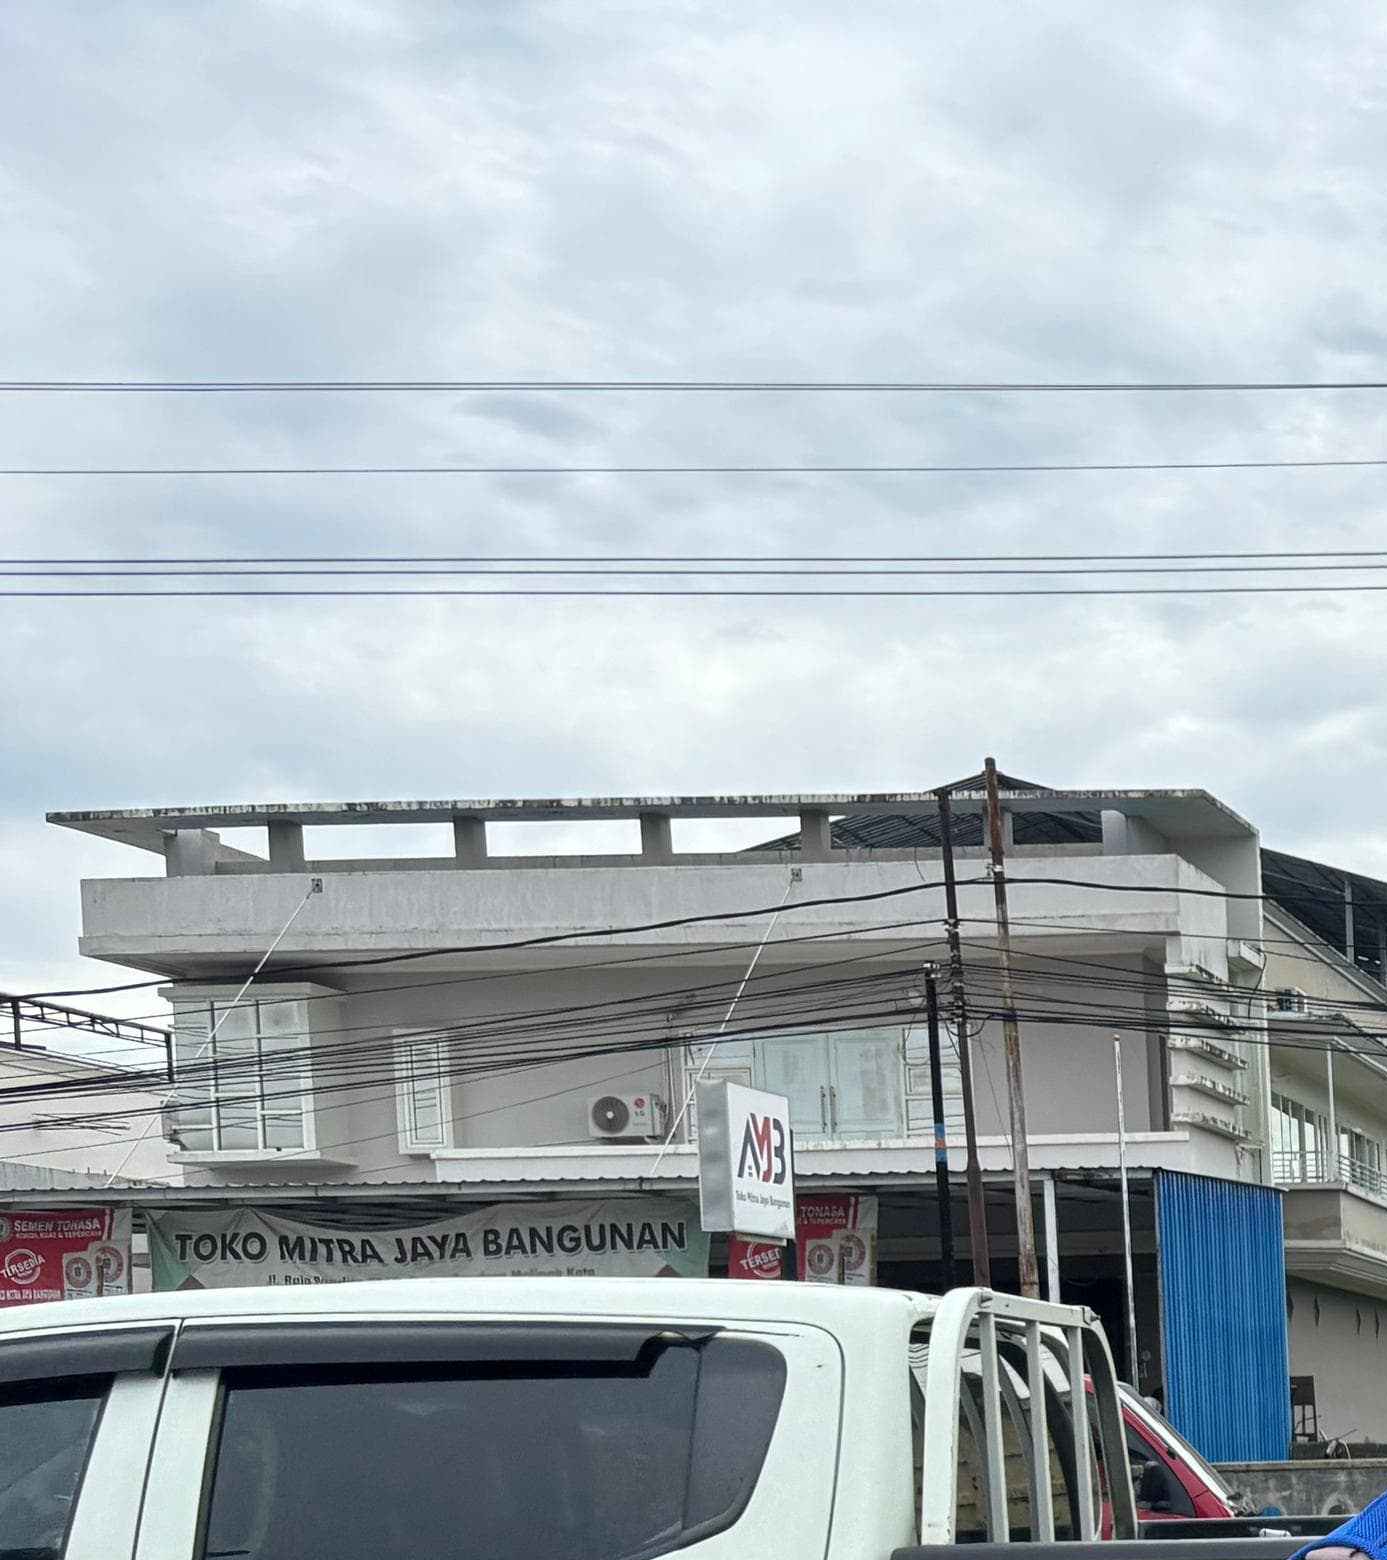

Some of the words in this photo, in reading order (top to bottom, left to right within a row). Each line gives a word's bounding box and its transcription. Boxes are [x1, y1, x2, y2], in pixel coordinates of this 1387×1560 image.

[800, 1206, 845, 1217] TONASA
[14, 1220, 53, 1232] SEMEN
[175, 1231, 269, 1263] TOKO
[278, 1234, 385, 1265] MITRA
[393, 1233, 473, 1263] JAYA
[483, 1221, 687, 1257] BANGUNAN
